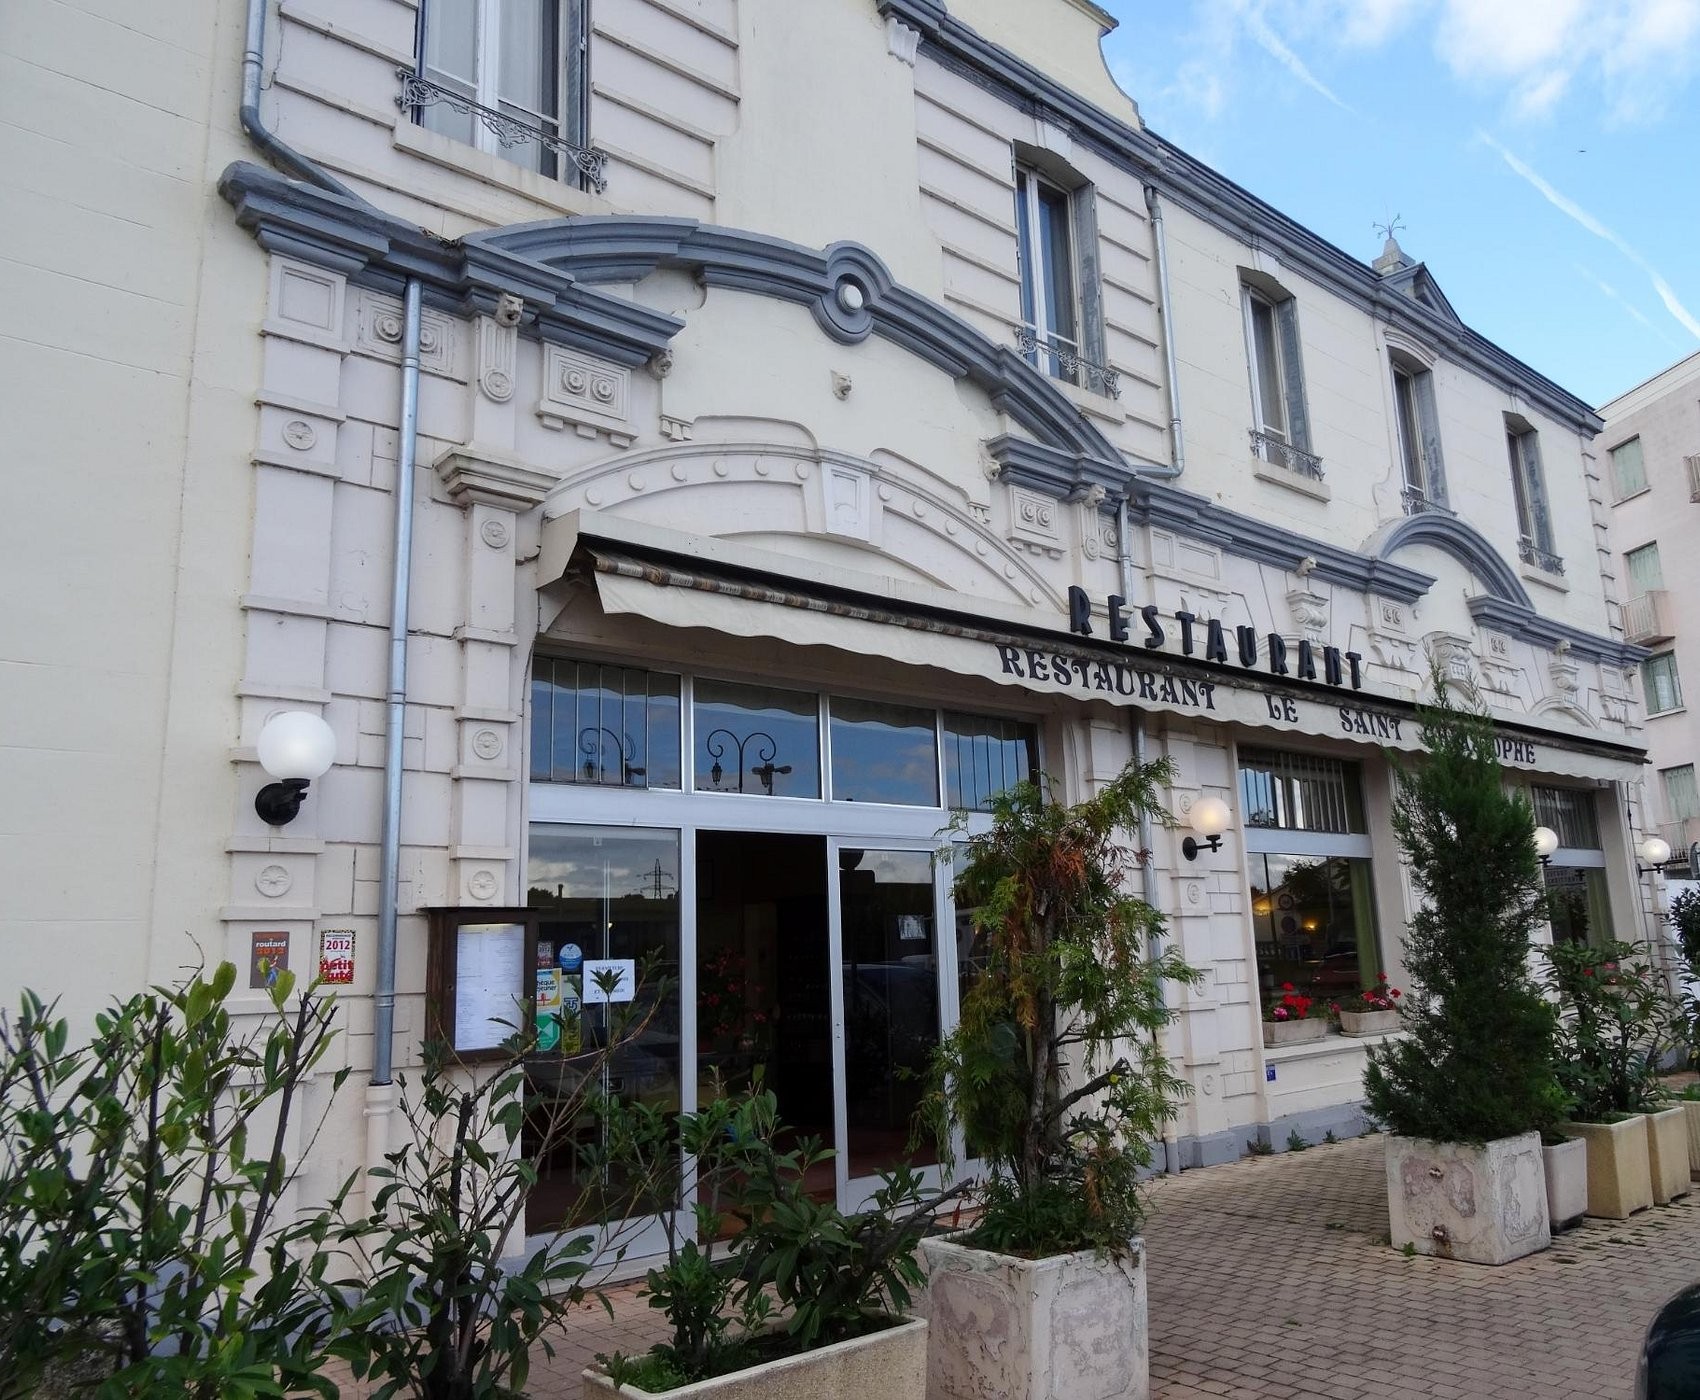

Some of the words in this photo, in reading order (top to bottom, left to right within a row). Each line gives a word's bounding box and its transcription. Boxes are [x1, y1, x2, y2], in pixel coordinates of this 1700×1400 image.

[1068, 585, 1362, 689] RESTAURANT
[995, 644, 1215, 710] RESTAURANT
[1264, 694, 1298, 722] LE
[1339, 707, 1402, 741] SAINT
[256, 938, 286, 948] routard
[326, 940, 350, 950] 2012
